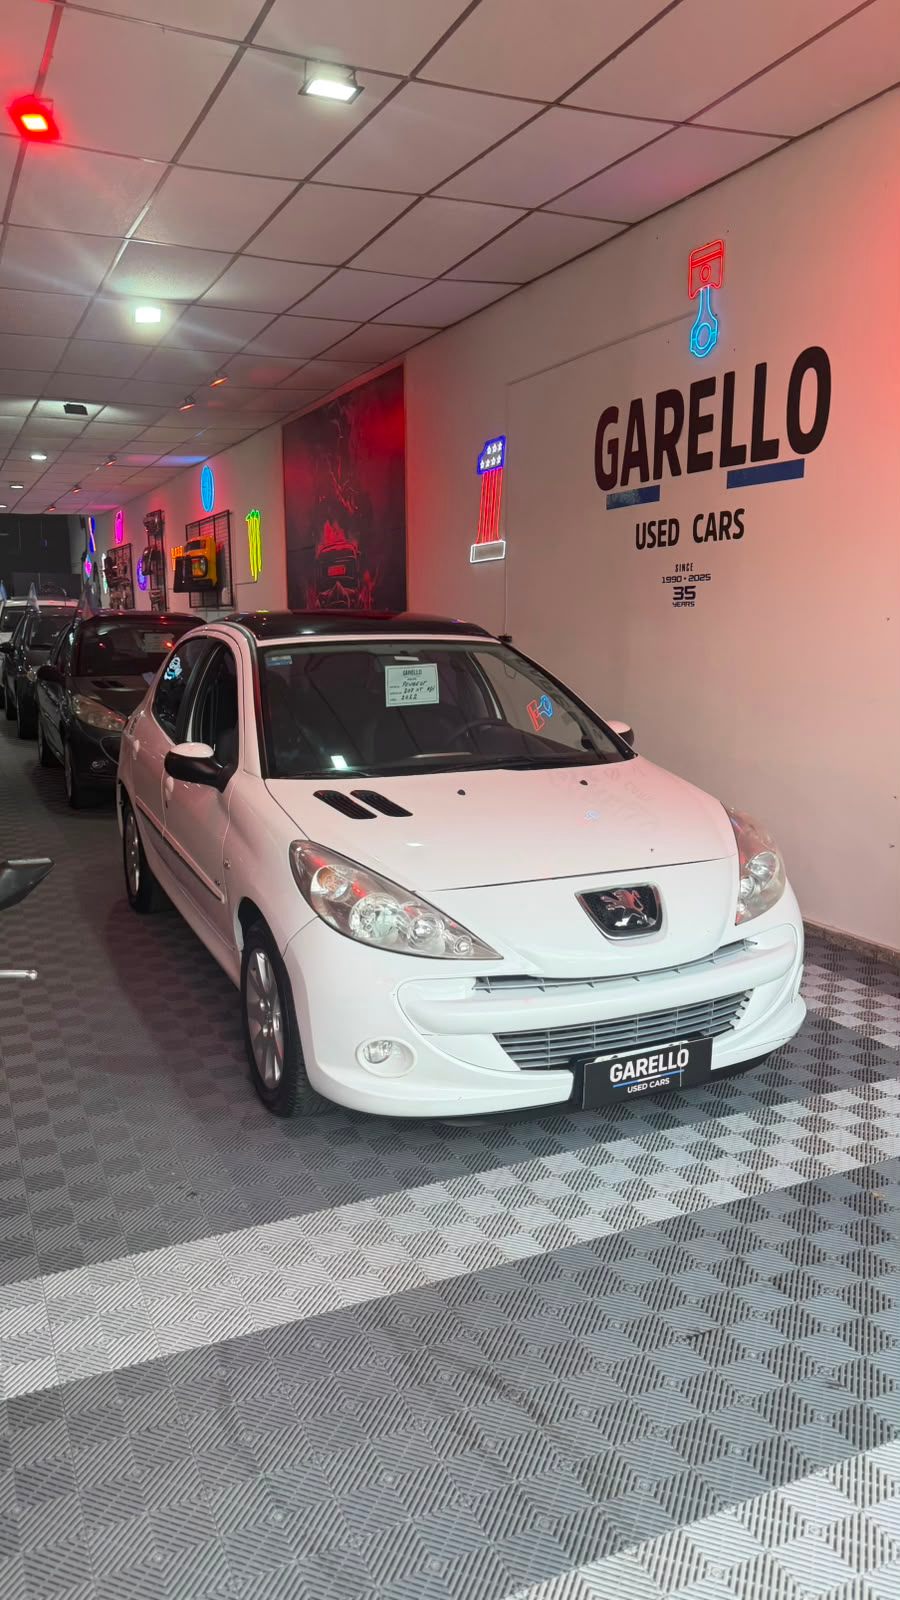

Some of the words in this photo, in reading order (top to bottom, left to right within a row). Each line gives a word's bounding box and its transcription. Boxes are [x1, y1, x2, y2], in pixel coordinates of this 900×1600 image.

[594, 346, 831, 491] GARELLO
[635, 518, 680, 550] USED
[692, 508, 745, 543] CARS
[675, 562, 694, 573] SINCE
[662, 575, 682, 584] 1990
[688, 573, 712, 582] 2025
[672, 585, 696, 600] 35
[609, 1048, 690, 1083] GARELLO
[627, 1082, 648, 1093] USED
[649, 1077, 670, 1088] CARS
